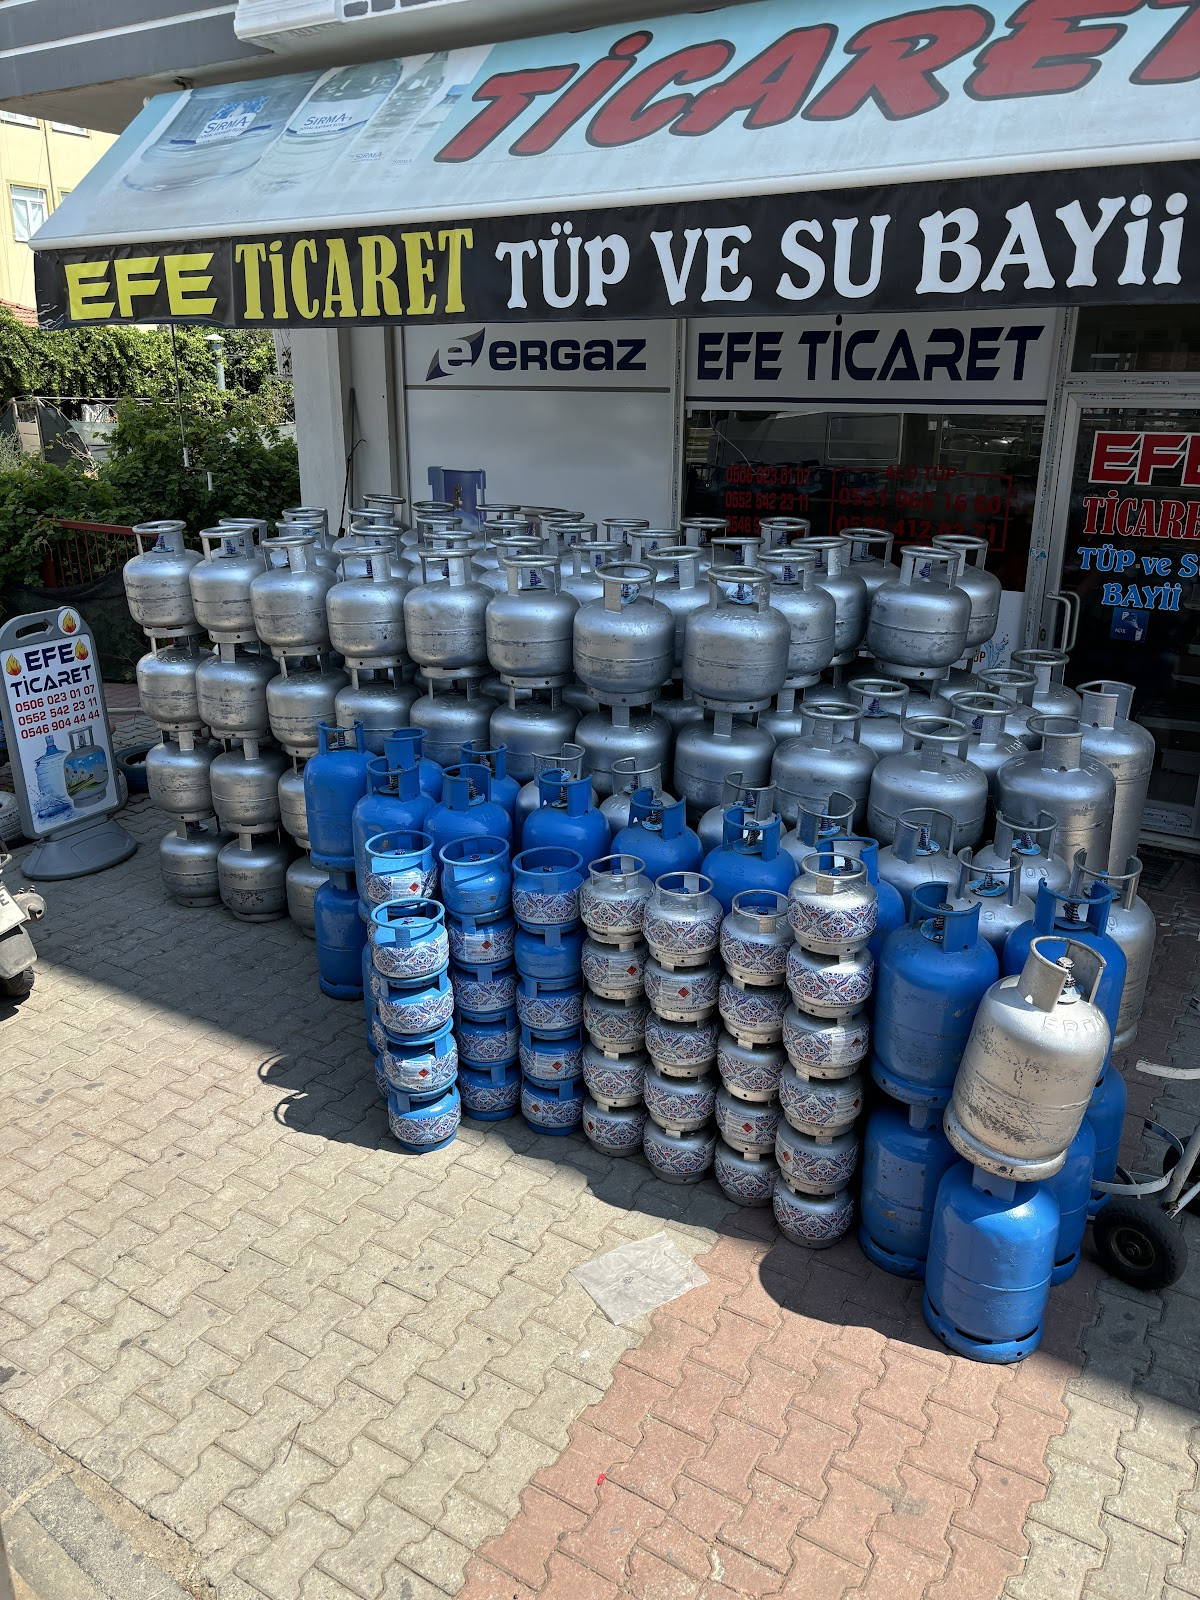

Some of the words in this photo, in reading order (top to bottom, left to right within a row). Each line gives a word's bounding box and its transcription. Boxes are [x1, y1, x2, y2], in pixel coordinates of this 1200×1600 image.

[64, 252, 218, 321] EFE
[495, 220, 630, 309] TÜP
[650, 224, 752, 306] VE
[776, 213, 891, 300] SU
[697, 331, 784, 381] EFE
[798, 314, 1046, 381] TİCARET
[796, 467, 812, 487] 07
[798, 493, 809, 514] 11
[838, 485, 888, 510] 0551
[895, 488, 936, 511] 965
[944, 492, 969, 513] 16
[973, 494, 1003, 517] 60
[892, 519, 932, 540] 412
[1077, 543, 1136, 573] TÜP
[1141, 556, 1172, 576] ve
[24, 642, 76, 672] EFE
[10, 664, 92, 697] TİCARET
[15, 697, 44, 713] 0506
[47, 692, 67, 706] 023
[70, 688, 81, 699] 01
[83, 684, 95, 695] 07
[18, 711, 47, 726] 0552
[49, 705, 69, 718] 542
[72, 700, 86, 712] 23
[88, 697, 98, 707] 11
[21, 724, 49, 739] 0546
[51, 717, 71, 731] 904
[73, 713, 86, 725] 44
[88, 709, 100, 720] 44
